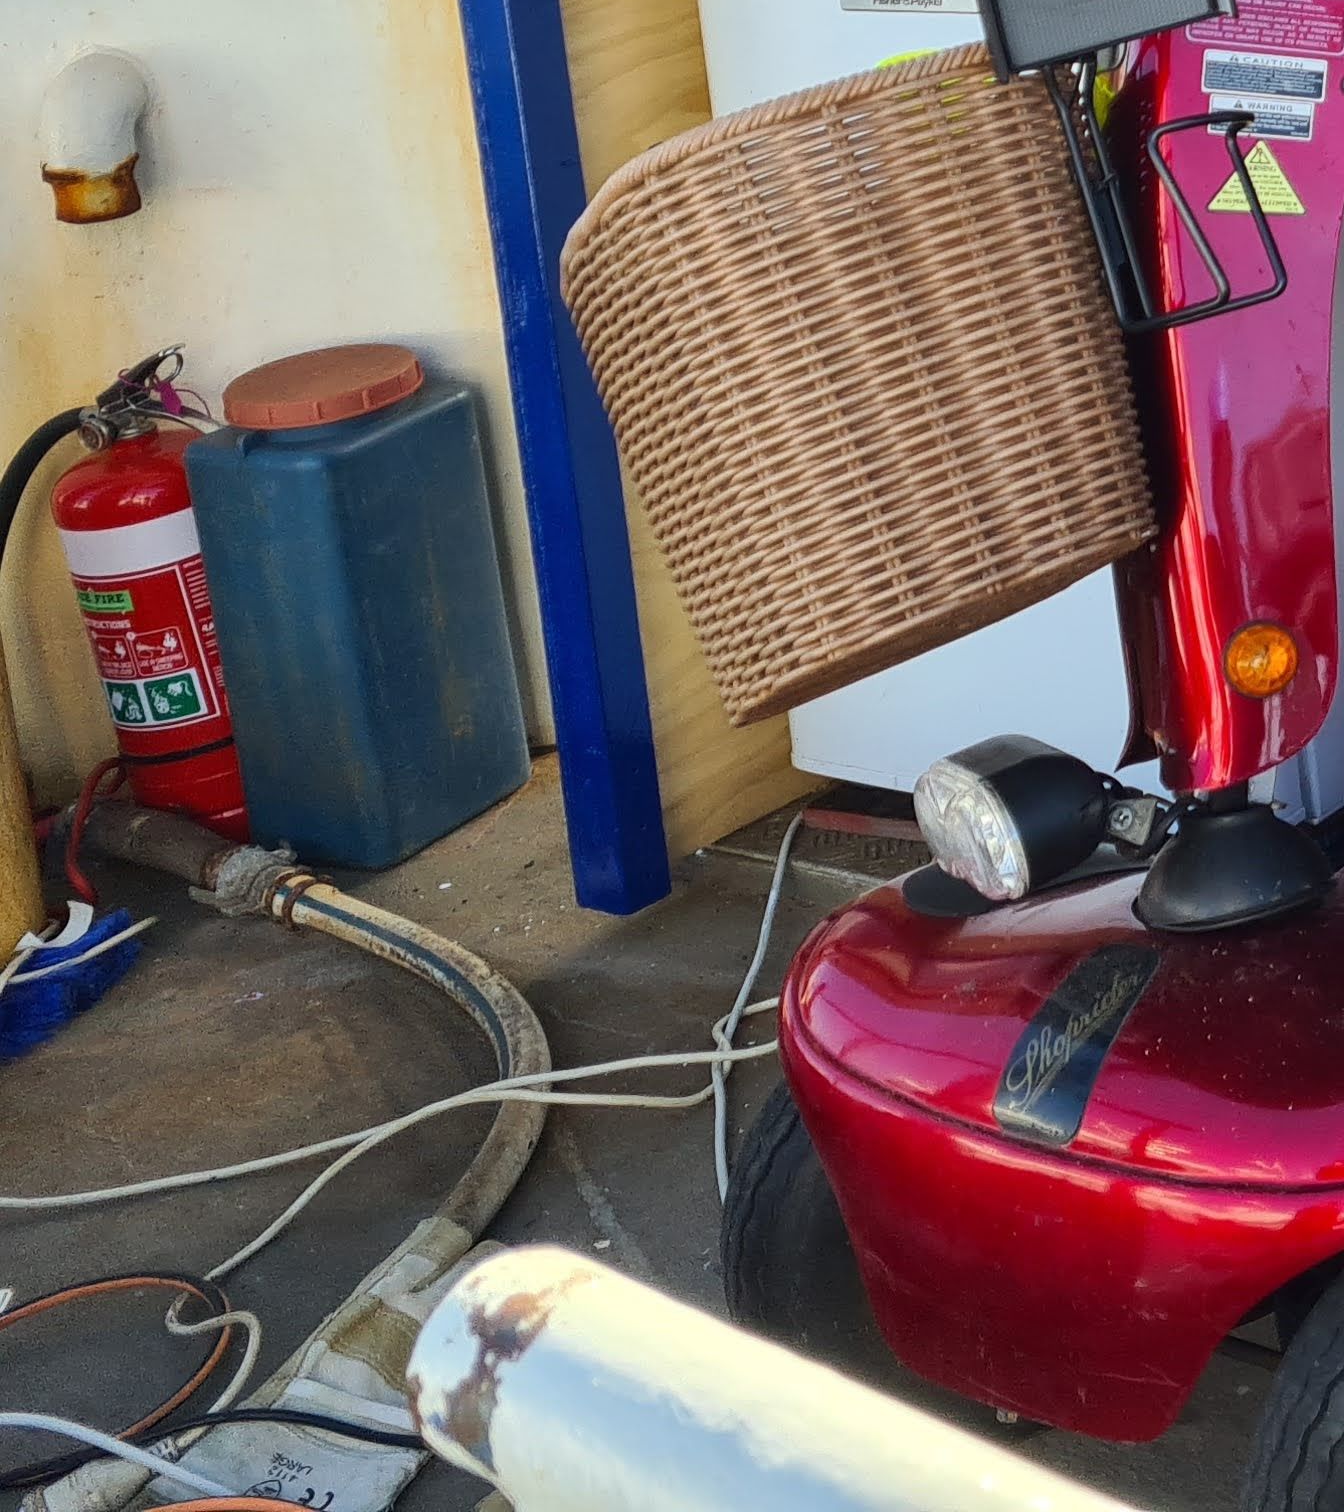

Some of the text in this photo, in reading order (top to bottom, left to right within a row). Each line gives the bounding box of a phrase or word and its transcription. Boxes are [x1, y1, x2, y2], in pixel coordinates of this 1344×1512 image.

[1242, 56, 1304, 69] CAUTION
[1247, 101, 1294, 113] WARNING
[94, 593, 126, 605] FIRE
[272, 1452, 314, 1476] LARGE
